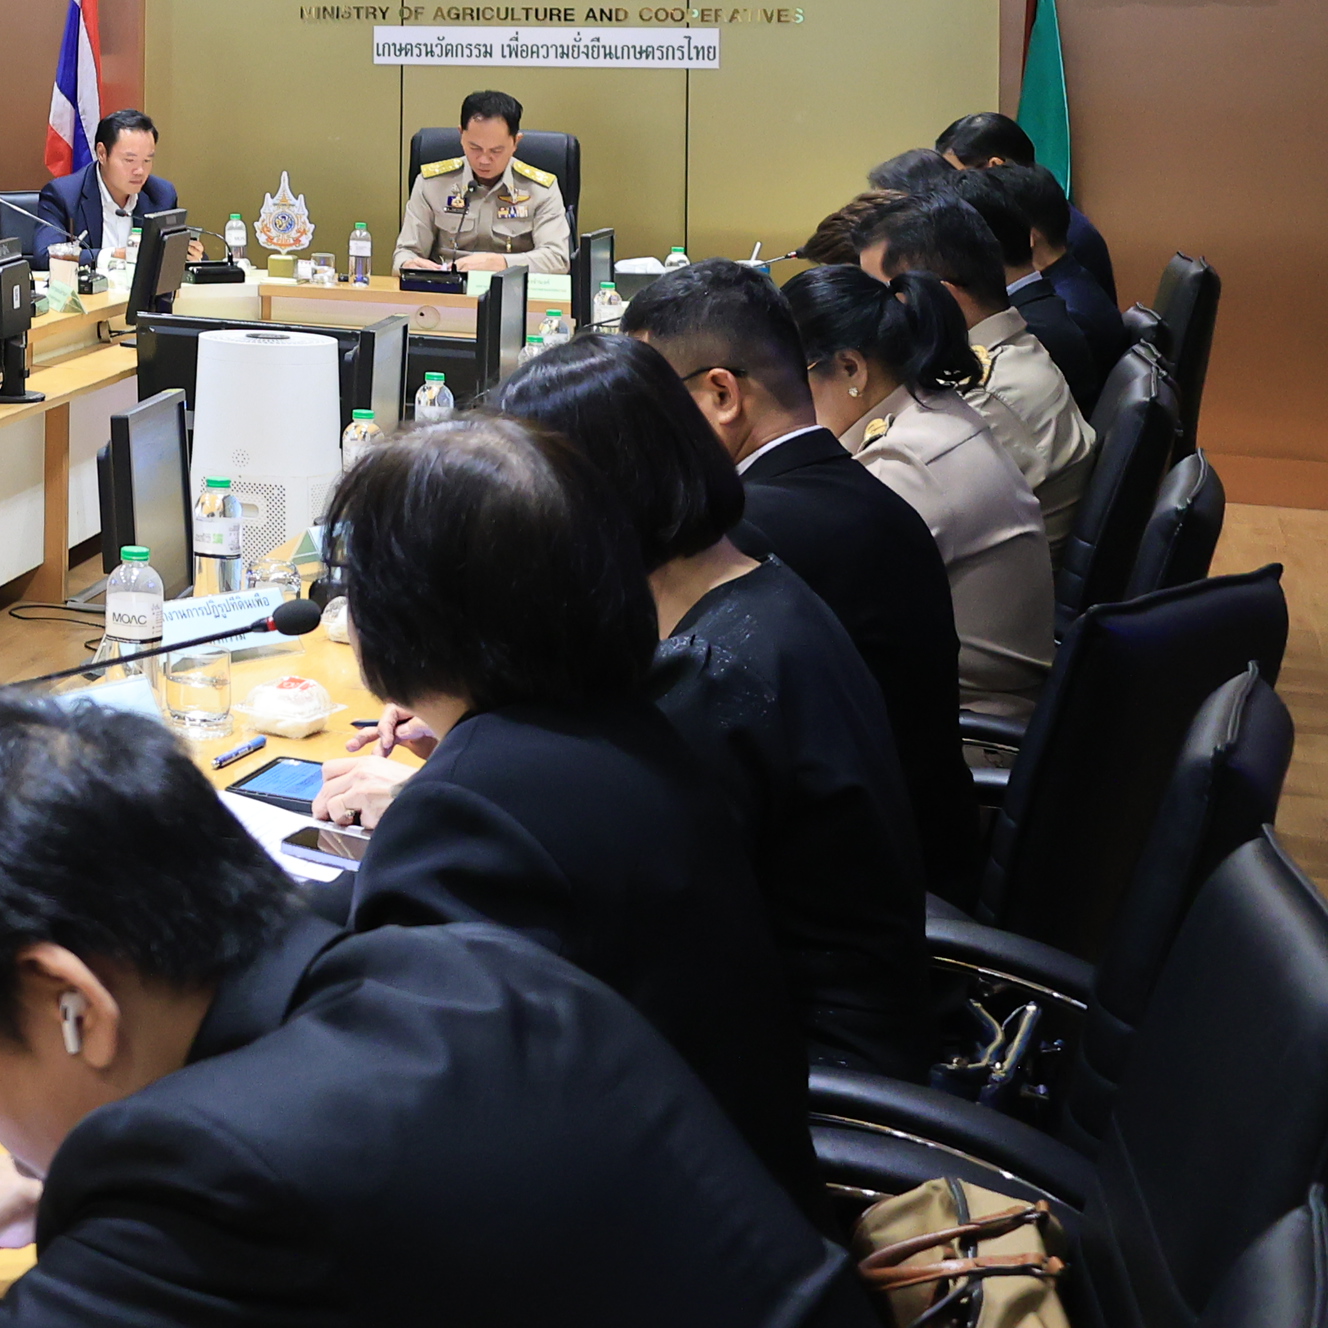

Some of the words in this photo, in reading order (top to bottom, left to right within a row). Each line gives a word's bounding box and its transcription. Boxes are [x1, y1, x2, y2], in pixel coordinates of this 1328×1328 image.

[300, 5, 390, 21] MINISTRY
[399, 6, 425, 21] OF
[433, 6, 575, 22] AGRICULTURE
[585, 7, 629, 22] AND
[639, 7, 805, 24] COOPERATIVES
[376, 36, 493, 59] เกษตรนวัตกรรม
[501, 31, 717, 62] เพื่อความยั่งยืนเกษตรกรไทย
[112, 612, 148, 625] MOAC
